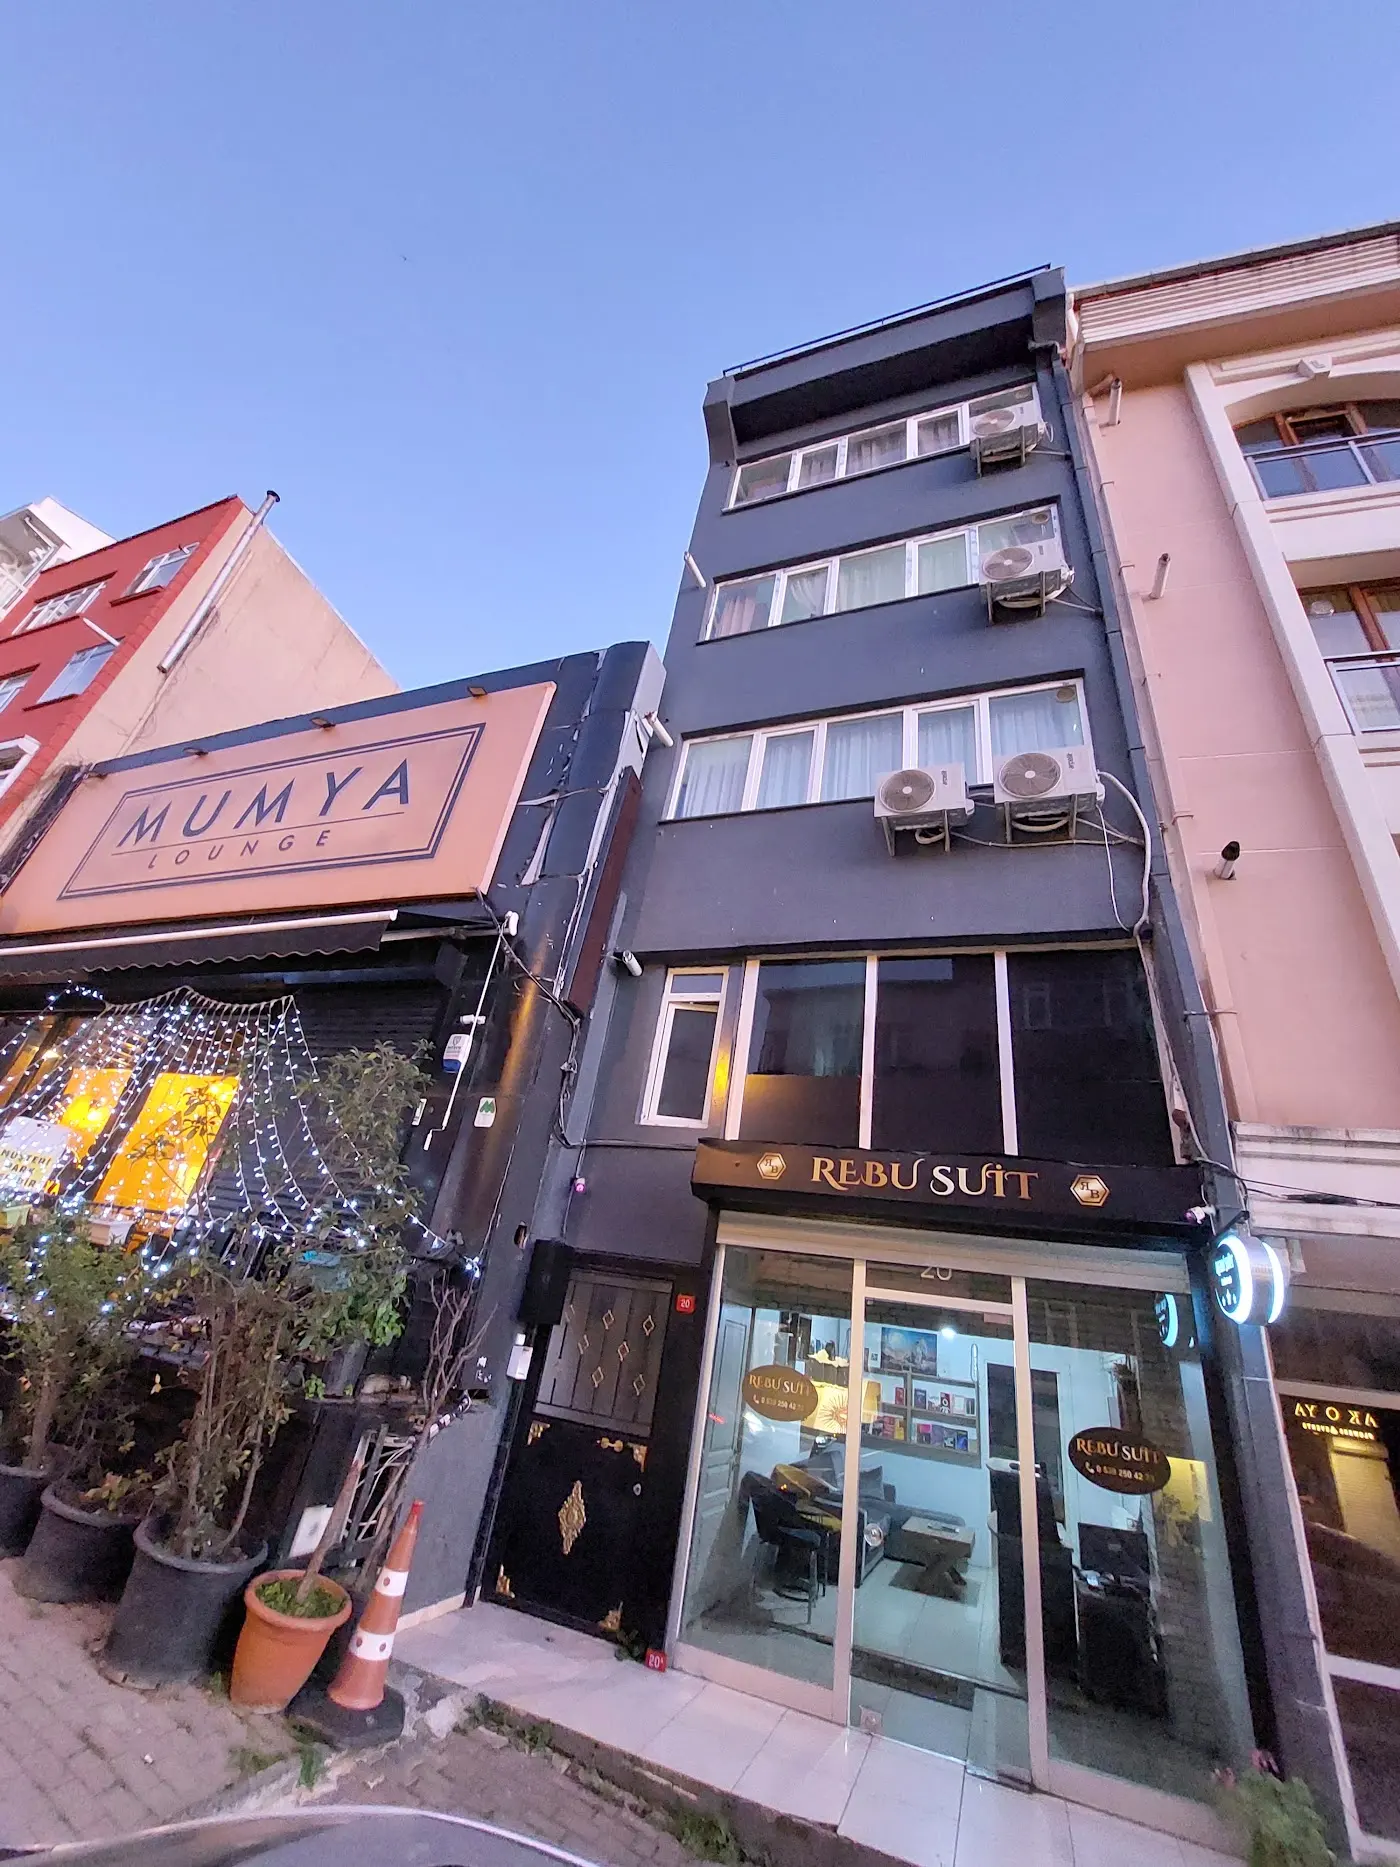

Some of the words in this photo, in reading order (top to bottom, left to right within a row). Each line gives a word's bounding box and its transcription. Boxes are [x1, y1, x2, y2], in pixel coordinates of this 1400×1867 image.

[117, 758, 409, 847] MUMYA
[148, 830, 330, 869] LOUNGE
[811, 1157, 925, 1191] REBU
[680, 1298, 690, 1309] 20
[750, 1374, 781, 1390] REBU
[1076, 1438, 1119, 1457] REBU
[649, 1654, 660, 1668] 20
